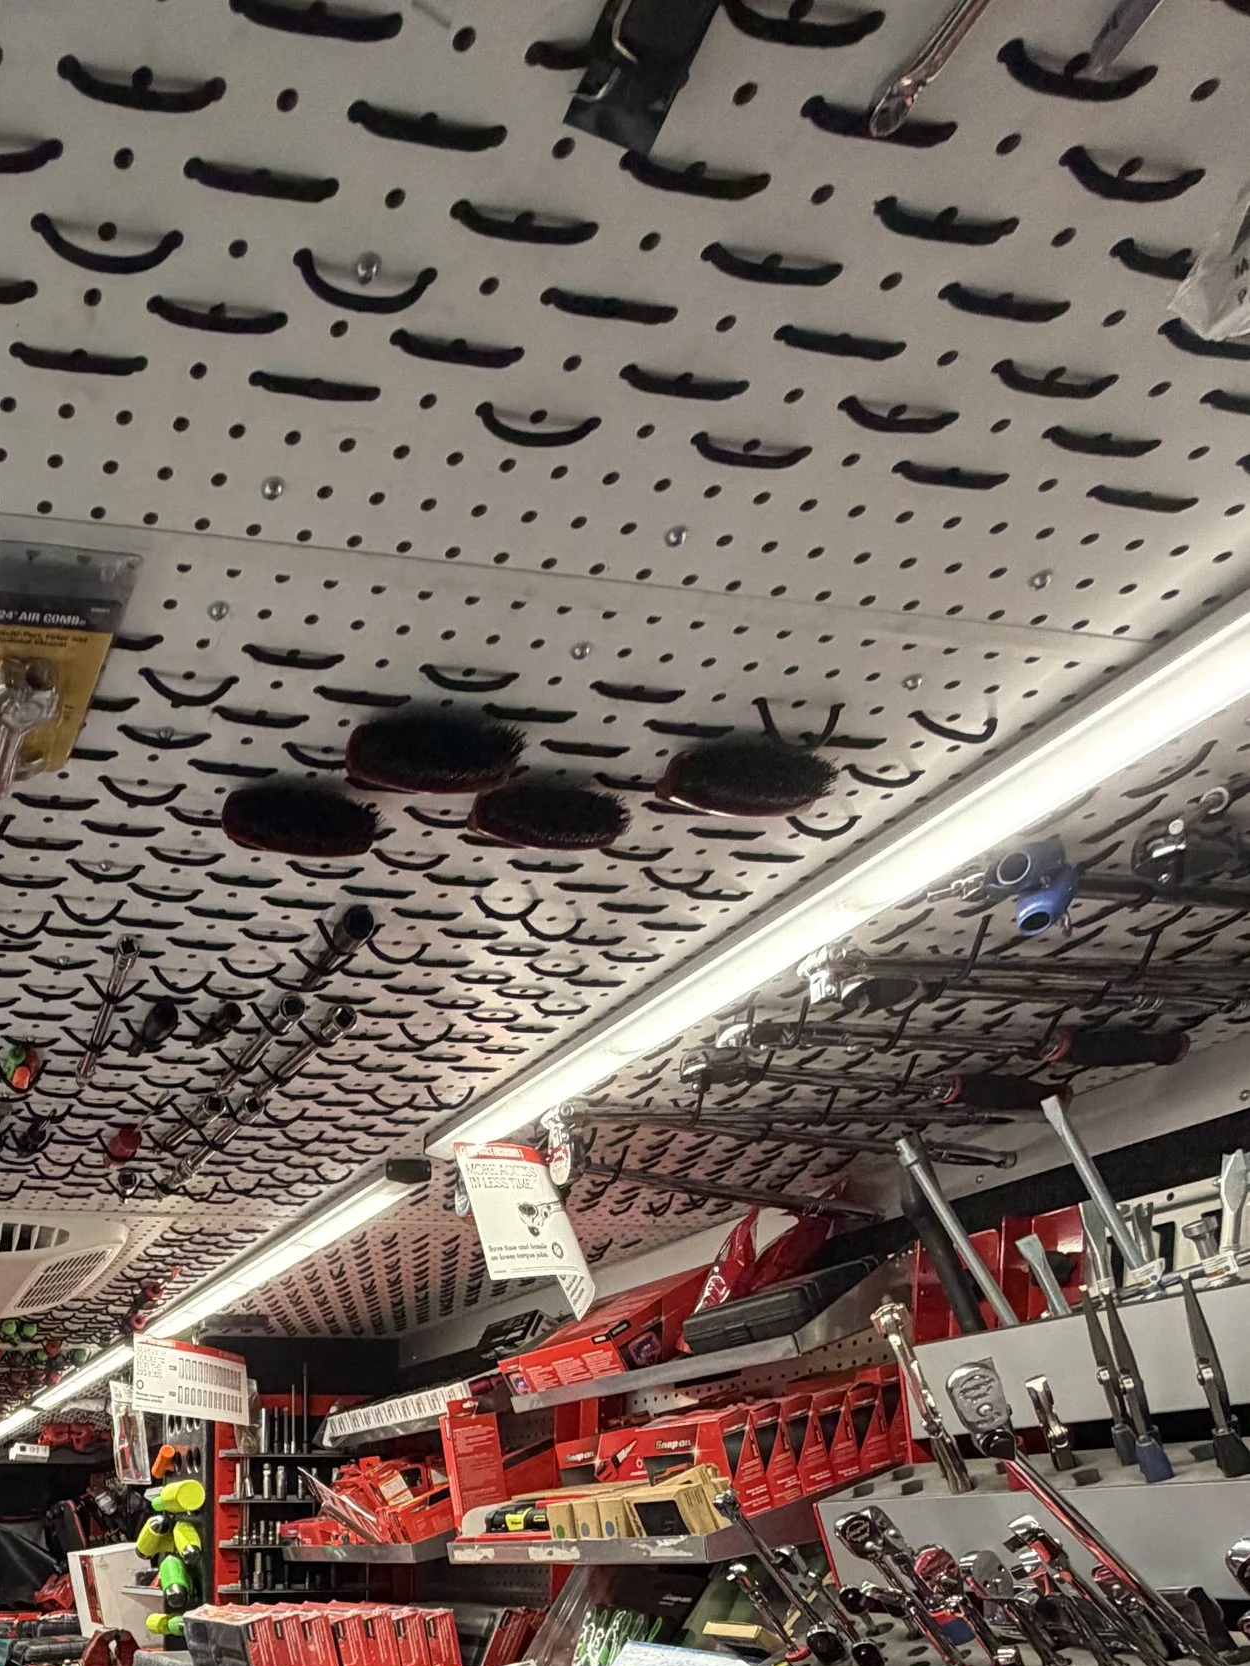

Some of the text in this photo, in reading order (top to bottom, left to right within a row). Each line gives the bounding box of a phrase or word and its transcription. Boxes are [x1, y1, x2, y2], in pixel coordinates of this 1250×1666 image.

[18, 611, 40, 623] AIR
[465, 1163, 498, 1177] MORE
[468, 1176, 481, 1189] IN
[483, 1177, 509, 1189] LESS
[504, 1243, 517, 1251] time
[518, 1243, 530, 1251] and
[654, 1439, 692, 1451] Snap-on
[565, 1450, 595, 1462] Snap-on
